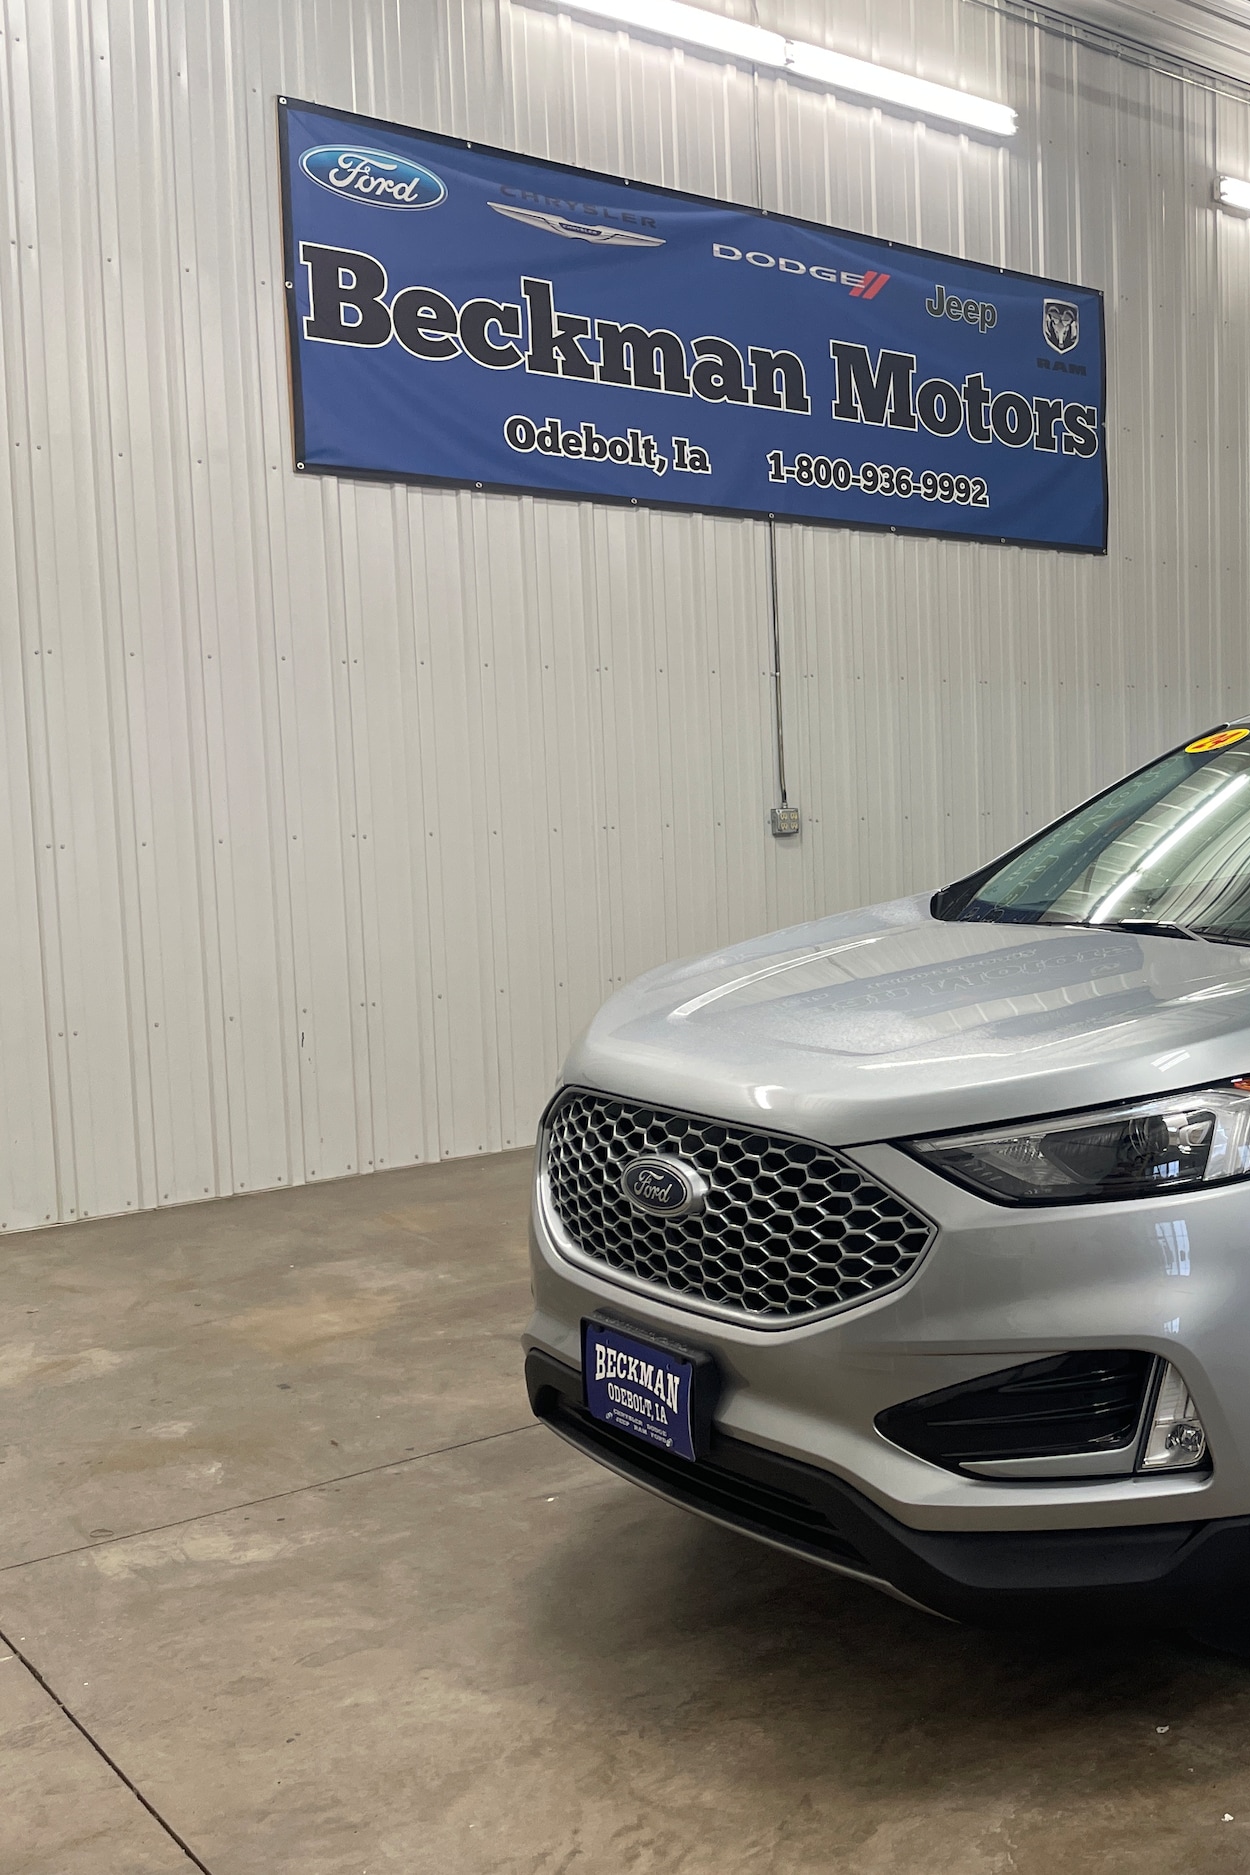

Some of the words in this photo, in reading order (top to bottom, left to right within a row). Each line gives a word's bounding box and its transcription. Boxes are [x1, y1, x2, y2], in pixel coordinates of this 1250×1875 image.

[328, 153, 420, 202] Ford
[500, 186, 657, 229] CHRYSLER
[712, 243, 866, 289] DODGE
[925, 284, 998, 334] Jeep
[298, 240, 812, 416] Beckman
[829, 338, 1100, 459] Motors
[1036, 357, 1088, 377] RAM
[503, 414, 669, 478] Odebolt,
[672, 436, 712, 475] Ia
[766, 448, 990, 508] 1-800-936-9992
[633, 1169, 673, 1204] Ford
[595, 1343, 680, 1415] BECKMAN
